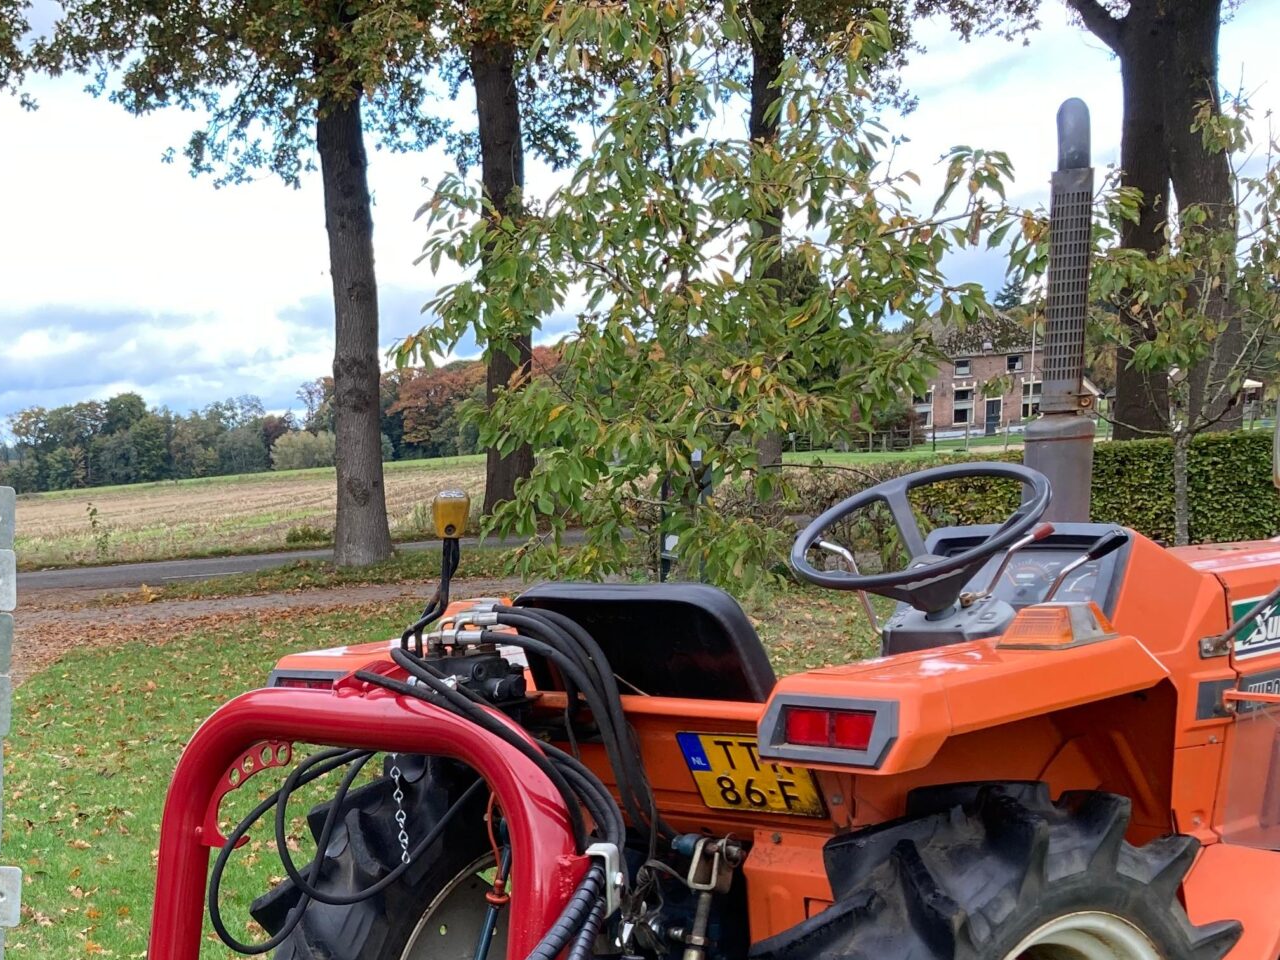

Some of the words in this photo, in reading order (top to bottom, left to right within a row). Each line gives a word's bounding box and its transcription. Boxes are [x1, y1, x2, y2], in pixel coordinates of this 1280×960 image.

[691, 756, 708, 767] NL
[713, 740, 795, 775] TT
[716, 775, 802, 811] 86-F
